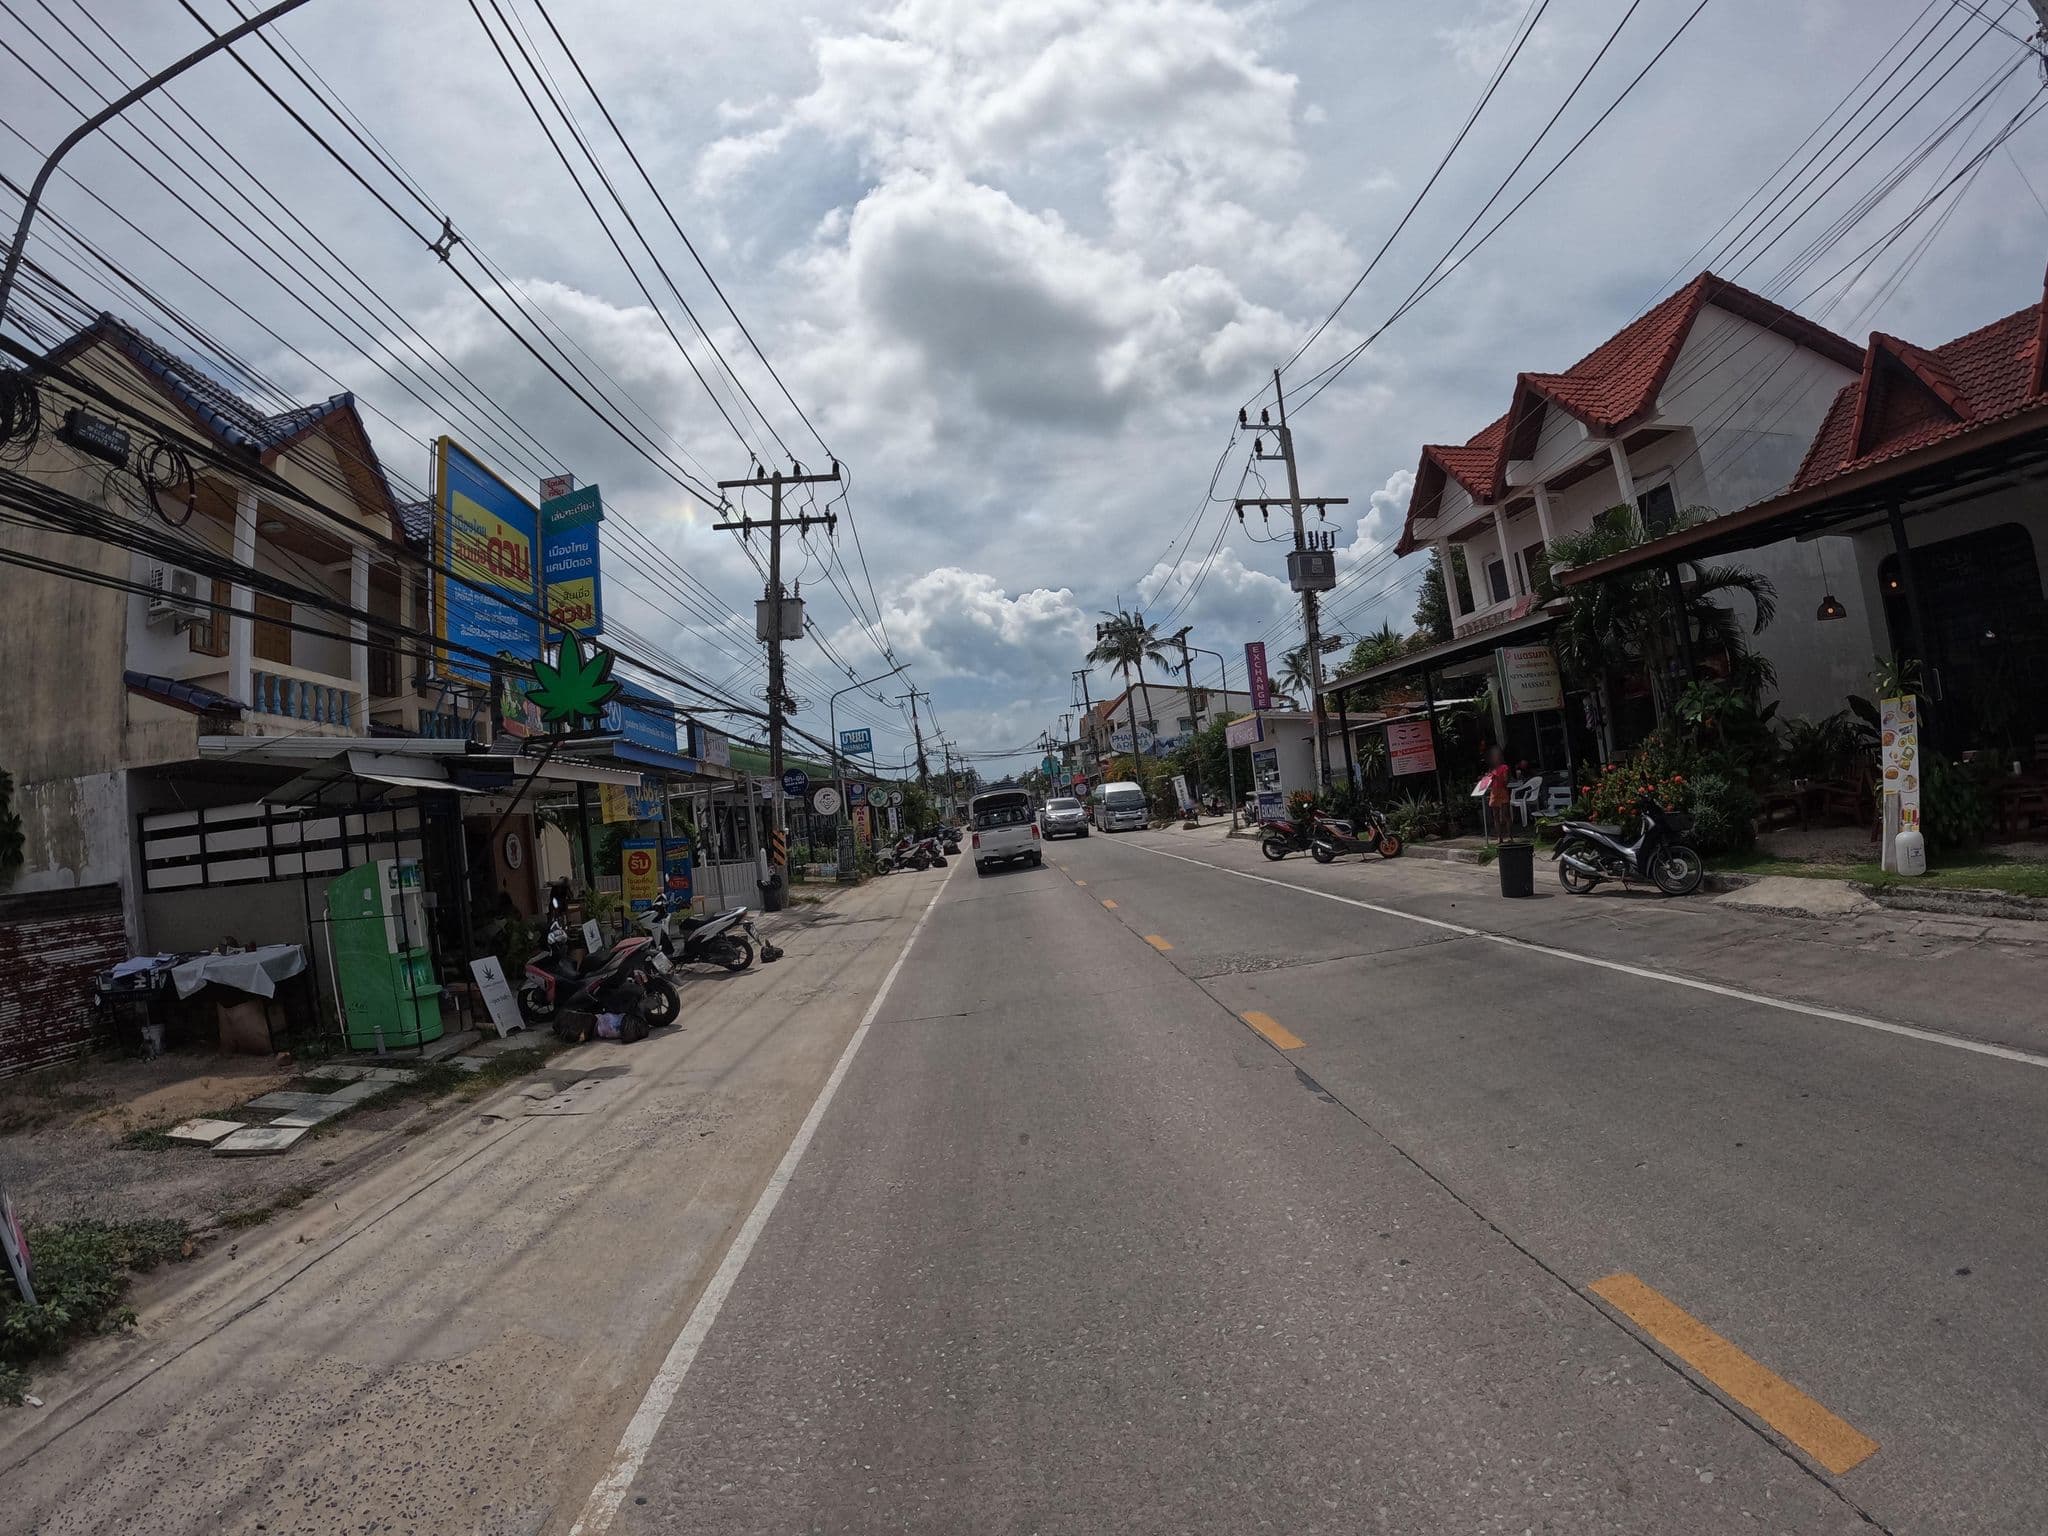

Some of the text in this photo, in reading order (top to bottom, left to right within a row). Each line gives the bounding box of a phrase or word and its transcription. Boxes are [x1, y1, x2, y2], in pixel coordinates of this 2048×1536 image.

[487, 524, 530, 581] ด่วน
[548, 542, 589, 557] เมืองไทย
[546, 557, 593, 573] แคปปิตอล
[1252, 646, 1266, 706] EXCHANGE
[842, 730, 869, 744] ขายยา
